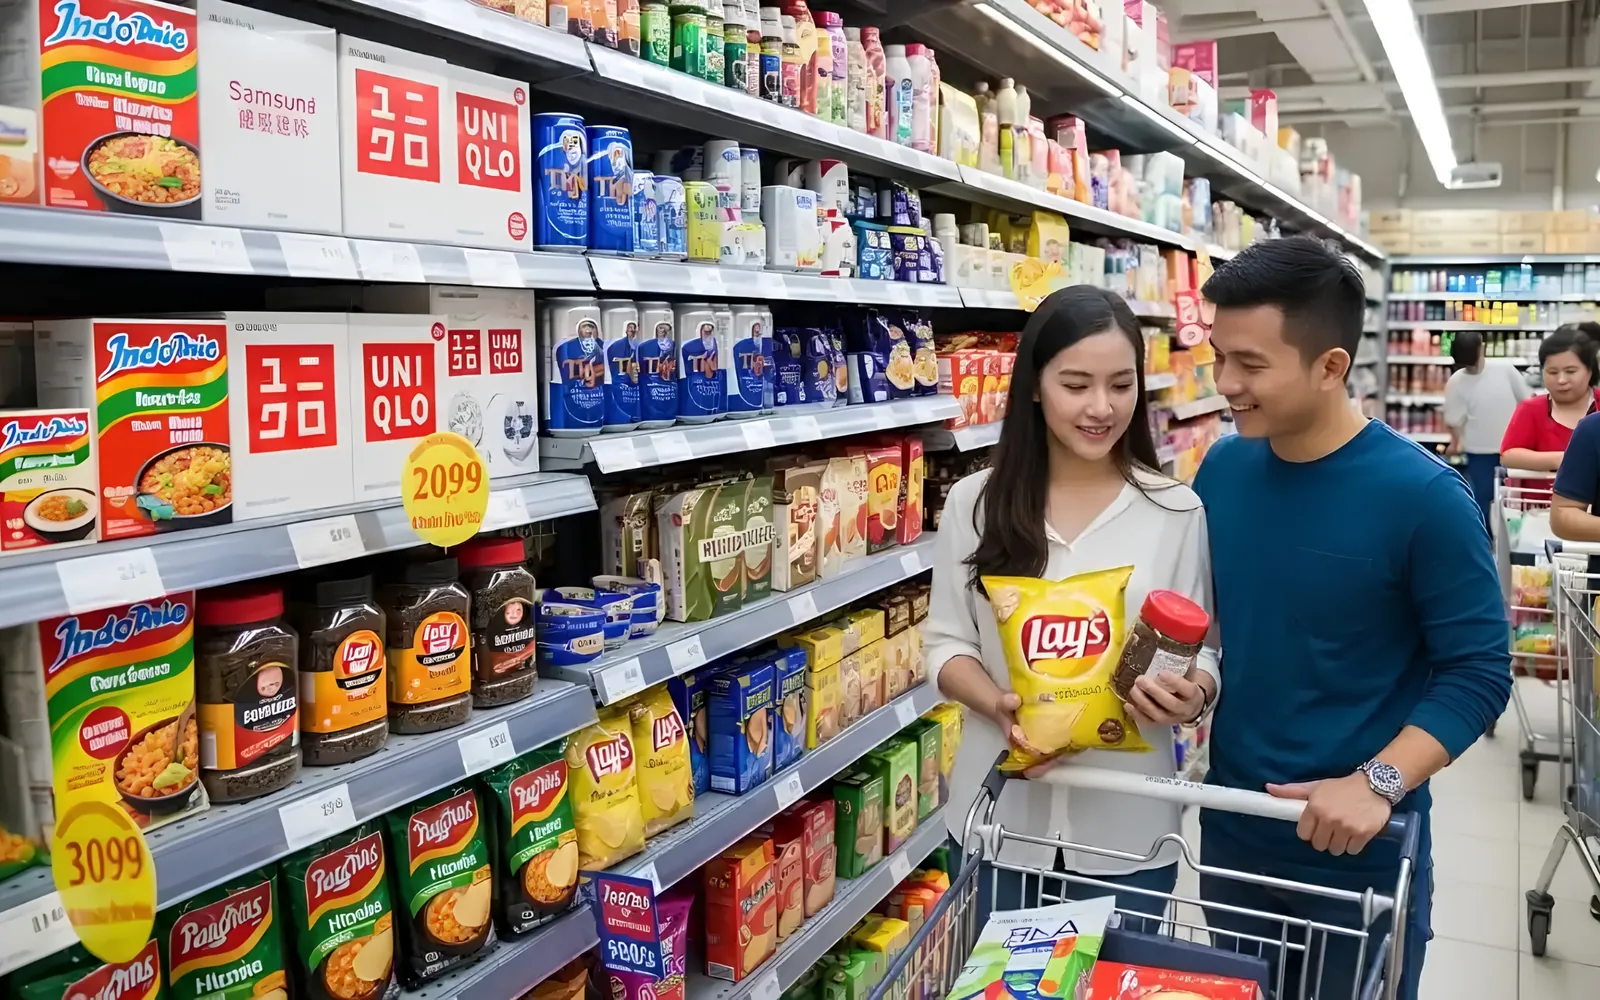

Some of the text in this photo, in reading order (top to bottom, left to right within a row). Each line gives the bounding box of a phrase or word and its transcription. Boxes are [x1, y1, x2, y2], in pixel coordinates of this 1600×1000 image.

[463, 106, 508, 143] UNI
[465, 143, 514, 180] QLO
[371, 355, 422, 388] UNI
[493, 351, 519, 370] QLO
[373, 393, 428, 434] QLO
[66, 835, 143, 886] 3099
